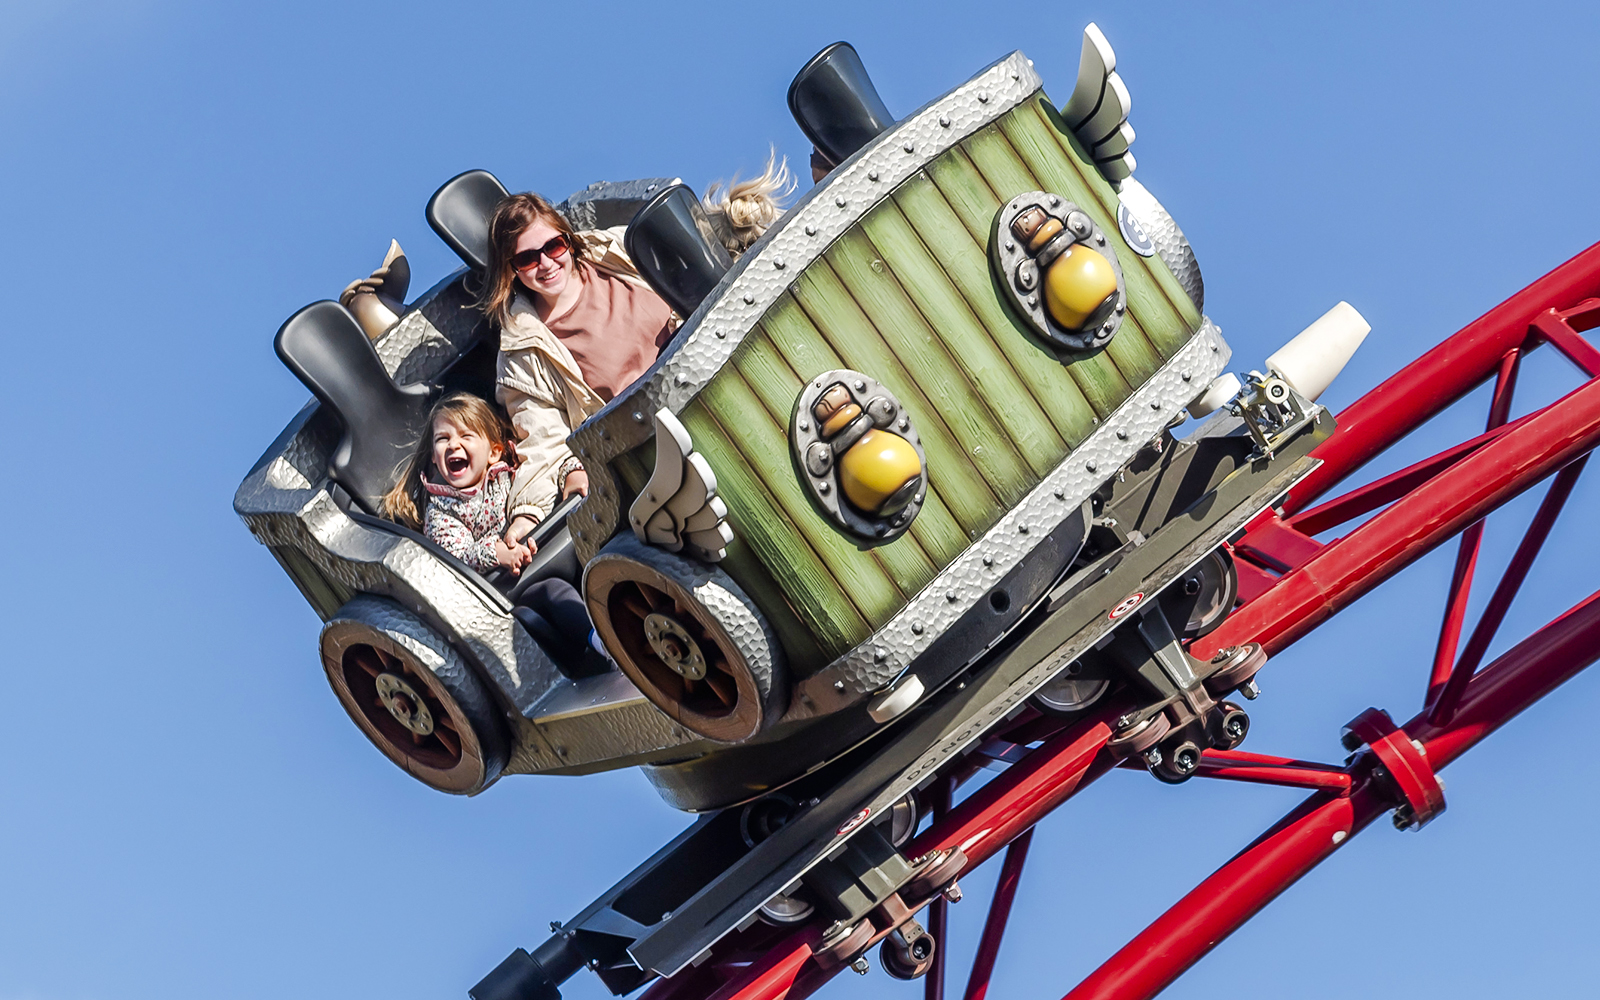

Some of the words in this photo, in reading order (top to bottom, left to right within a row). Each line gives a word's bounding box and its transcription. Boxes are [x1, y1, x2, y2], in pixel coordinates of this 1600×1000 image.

[907, 758, 936, 781] DO
[942, 720, 982, 753] NOT
[989, 675, 1039, 716] STEP
[1046, 647, 1076, 671] ON
